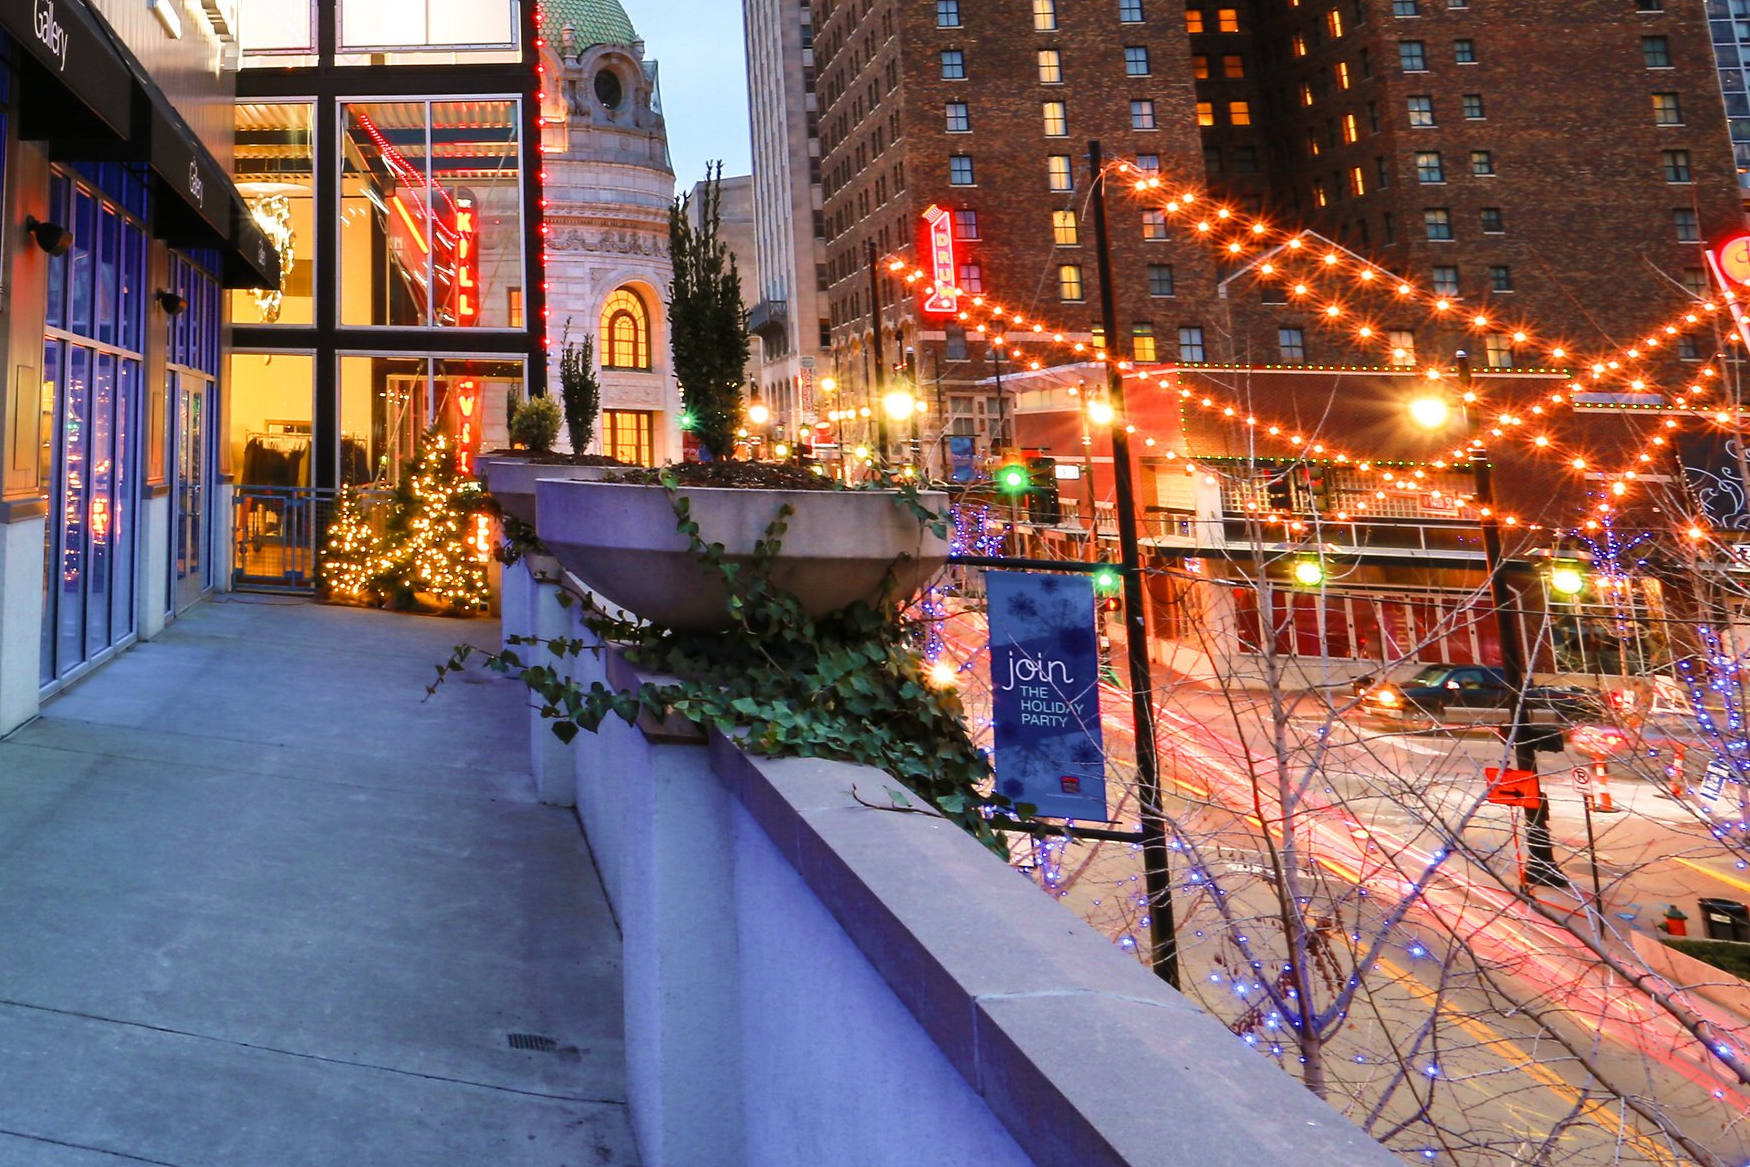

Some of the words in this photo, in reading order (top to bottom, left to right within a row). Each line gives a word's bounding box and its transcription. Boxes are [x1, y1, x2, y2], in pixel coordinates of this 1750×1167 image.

[456, 211, 474, 316] KILL
[936, 233, 956, 299] DRUM
[1001, 650, 1075, 691] join
[1019, 685, 1049, 699] THE
[1021, 713, 1068, 728] PARTY
